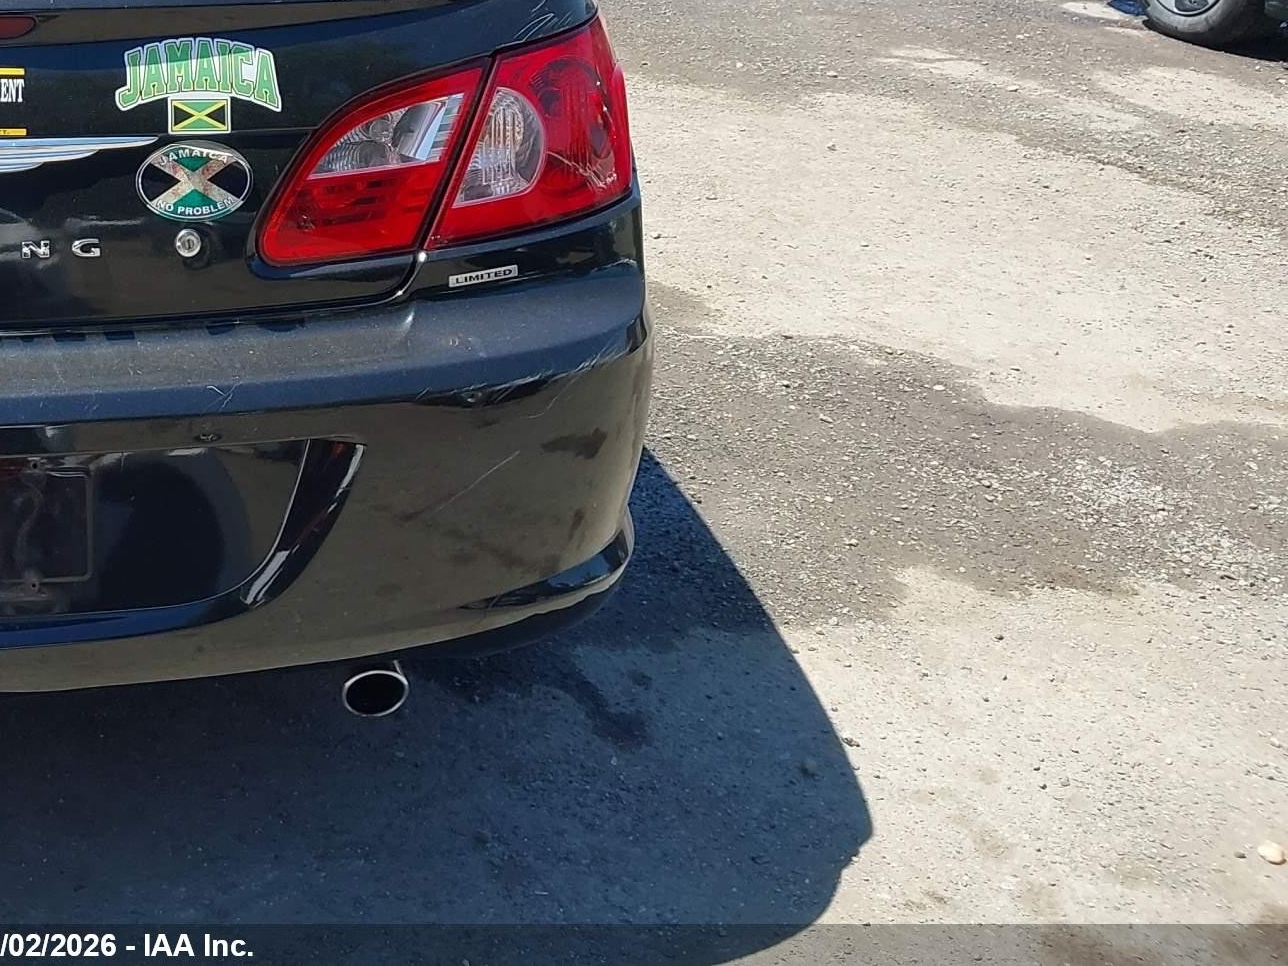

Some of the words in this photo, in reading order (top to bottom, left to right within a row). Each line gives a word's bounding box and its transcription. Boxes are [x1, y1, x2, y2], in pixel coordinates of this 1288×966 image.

[118, 39, 279, 109] JAMAICA
[159, 148, 228, 166] JAMAICA
[156, 199, 174, 212] NO
[177, 196, 234, 216] PROBLEM
[455, 268, 513, 284] LIMITED
